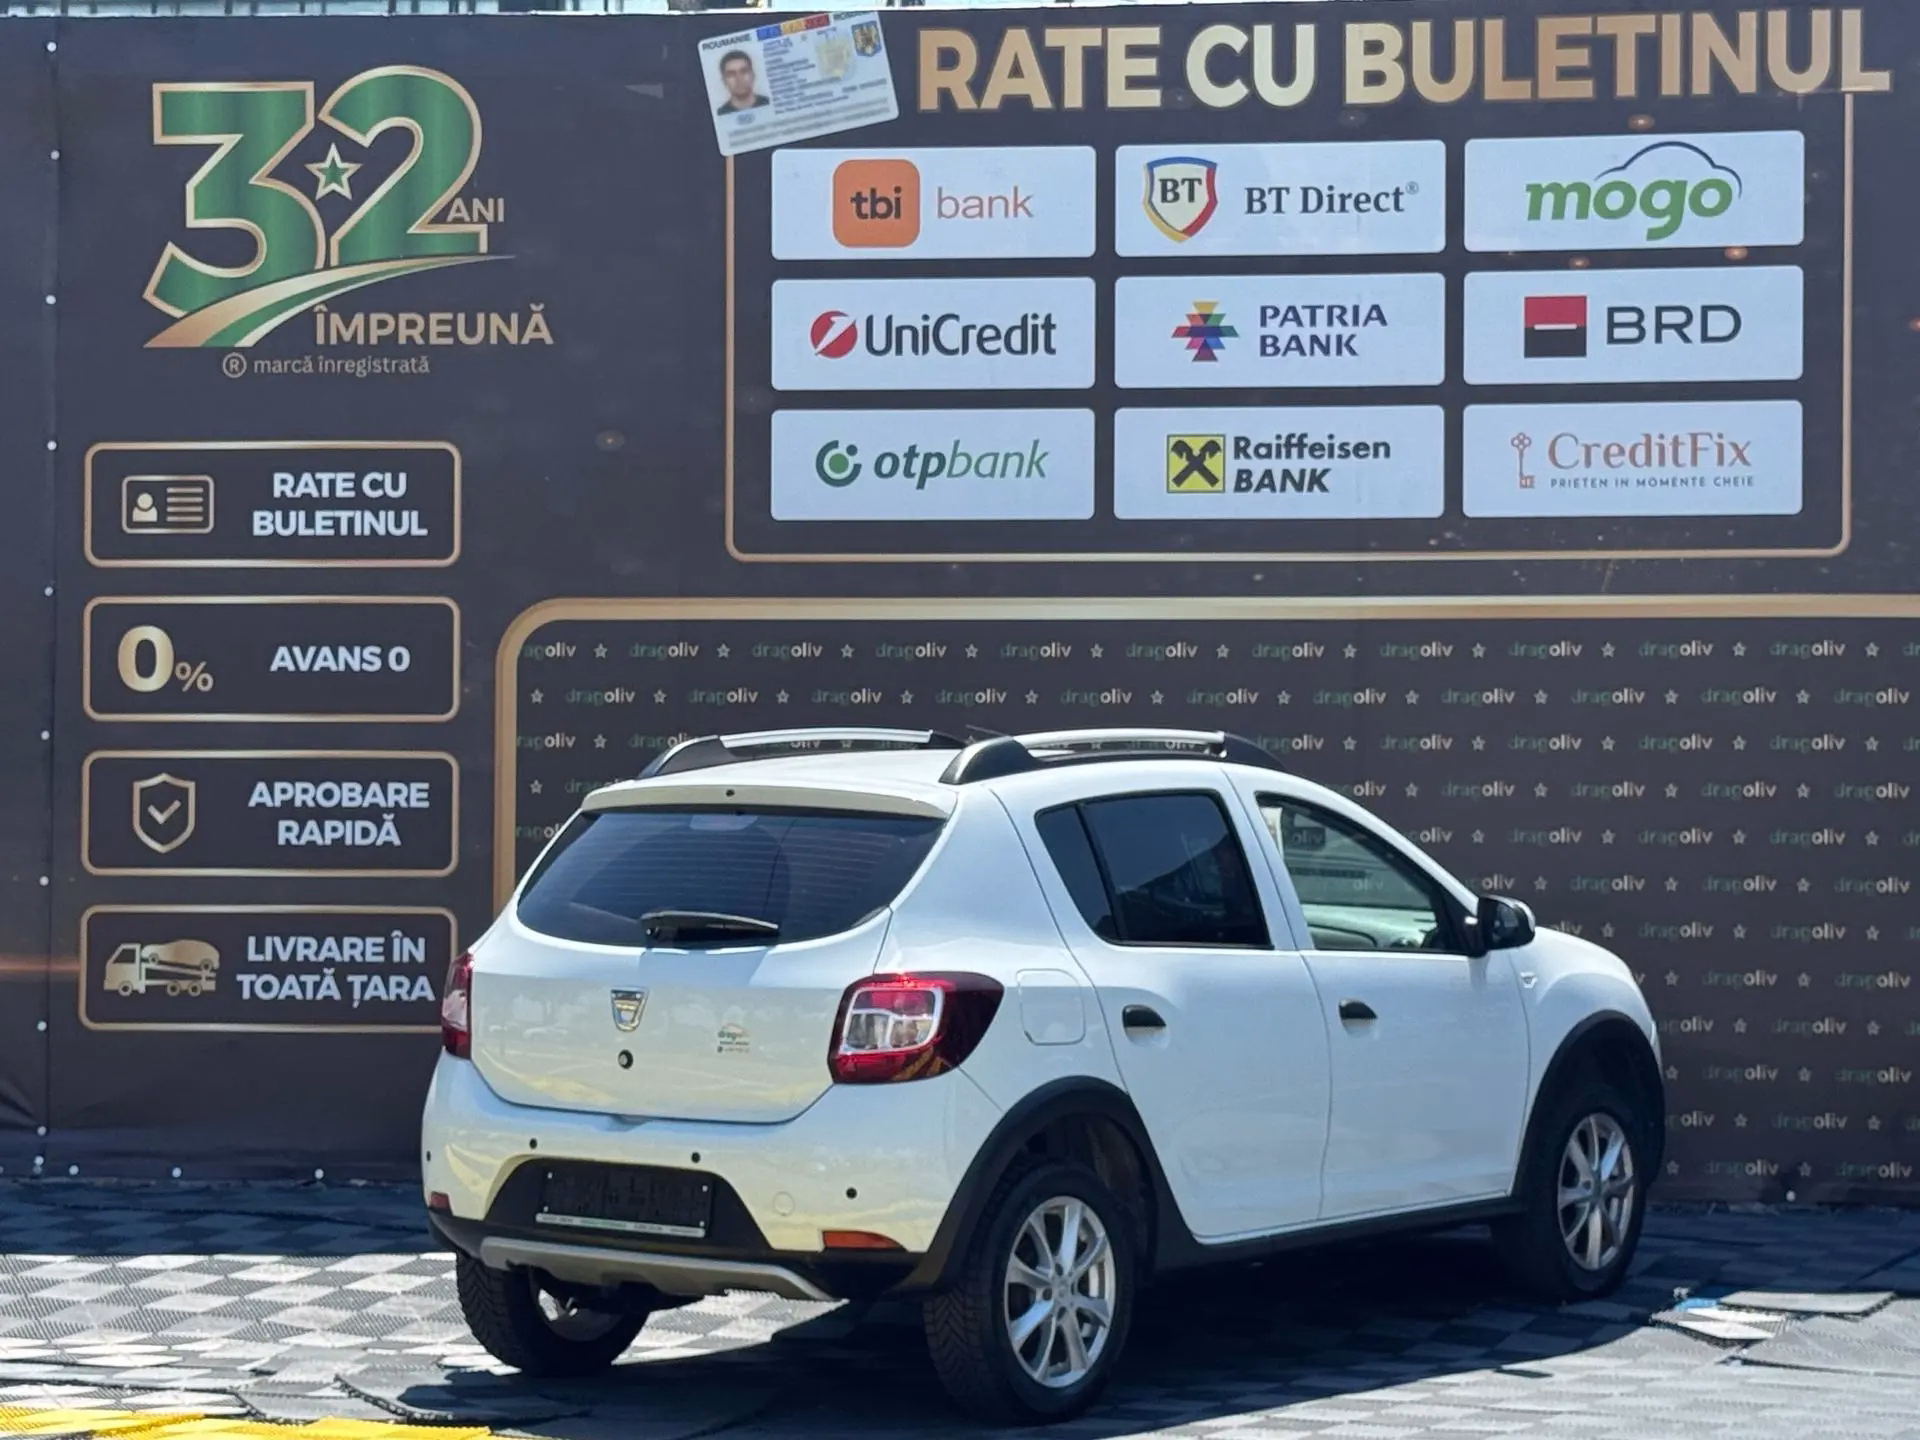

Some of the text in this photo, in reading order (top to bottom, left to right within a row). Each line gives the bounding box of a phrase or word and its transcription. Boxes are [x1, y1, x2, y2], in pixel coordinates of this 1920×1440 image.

[918, 26, 1162, 110] RATE
[1186, 22, 1317, 107] CU
[1345, 9, 1891, 104] BULETINUL
[142, 64, 489, 319] 32
[849, 185, 1035, 220] tbi bank
[1159, 177, 1203, 204] BT
[1244, 186, 1291, 215] BT
[446, 197, 505, 223] ANI
[1525, 177, 1733, 242] mogo
[313, 302, 554, 346] ÎMPREUNĂ
[1259, 303, 1389, 328] PATRIA
[1606, 304, 1743, 345] BRD
[864, 312, 1058, 357] UniCredit
[1259, 333, 1359, 358] BANK
[253, 355, 314, 374] marcă
[318, 354, 430, 377] înregistrată
[1232, 432, 1392, 462] Raiffeisen
[1548, 431, 1753, 470] CreditFix
[873, 439, 1050, 491] otpbank
[272, 471, 407, 499] RATE CU
[1232, 468, 1331, 494] BANK
[1550, 475, 1755, 489] PRIETEN IN MOMENTE CHEIE
[252, 510, 429, 537] BULETINUL
[269, 645, 411, 672] AVANS 0
[524, 639, 1846, 661] agoliv dragoliv dragoliv dragoliv dragoliv dragoliv dragoliv dragoliv dragoliv dragoliv dragoliv
[566, 687, 1909, 708] dragoliv dragoliv dragoliv dragoliv dragoliv dragoliv dragoliv dragoliv dragoliv dragoliv dragoliv
[517, 733, 576, 751] ragoliv
[1379, 734, 1453, 753] dragoliv
[1508, 734, 1582, 753] dragoliv
[1639, 733, 1713, 753] dragoliv
[1770, 734, 1846, 753] dragoliv
[247, 781, 430, 808] APROBARE
[1441, 780, 1515, 800] dragoliv
[1570, 781, 1646, 801] dragoliv
[1701, 781, 1777, 800] dragoliv
[1834, 782, 1910, 801] dragoliv
[277, 813, 401, 846] RAPIDĂ
[247, 930, 426, 963] LIVRARE ÎN
[236, 967, 341, 1001] TOATĂ
